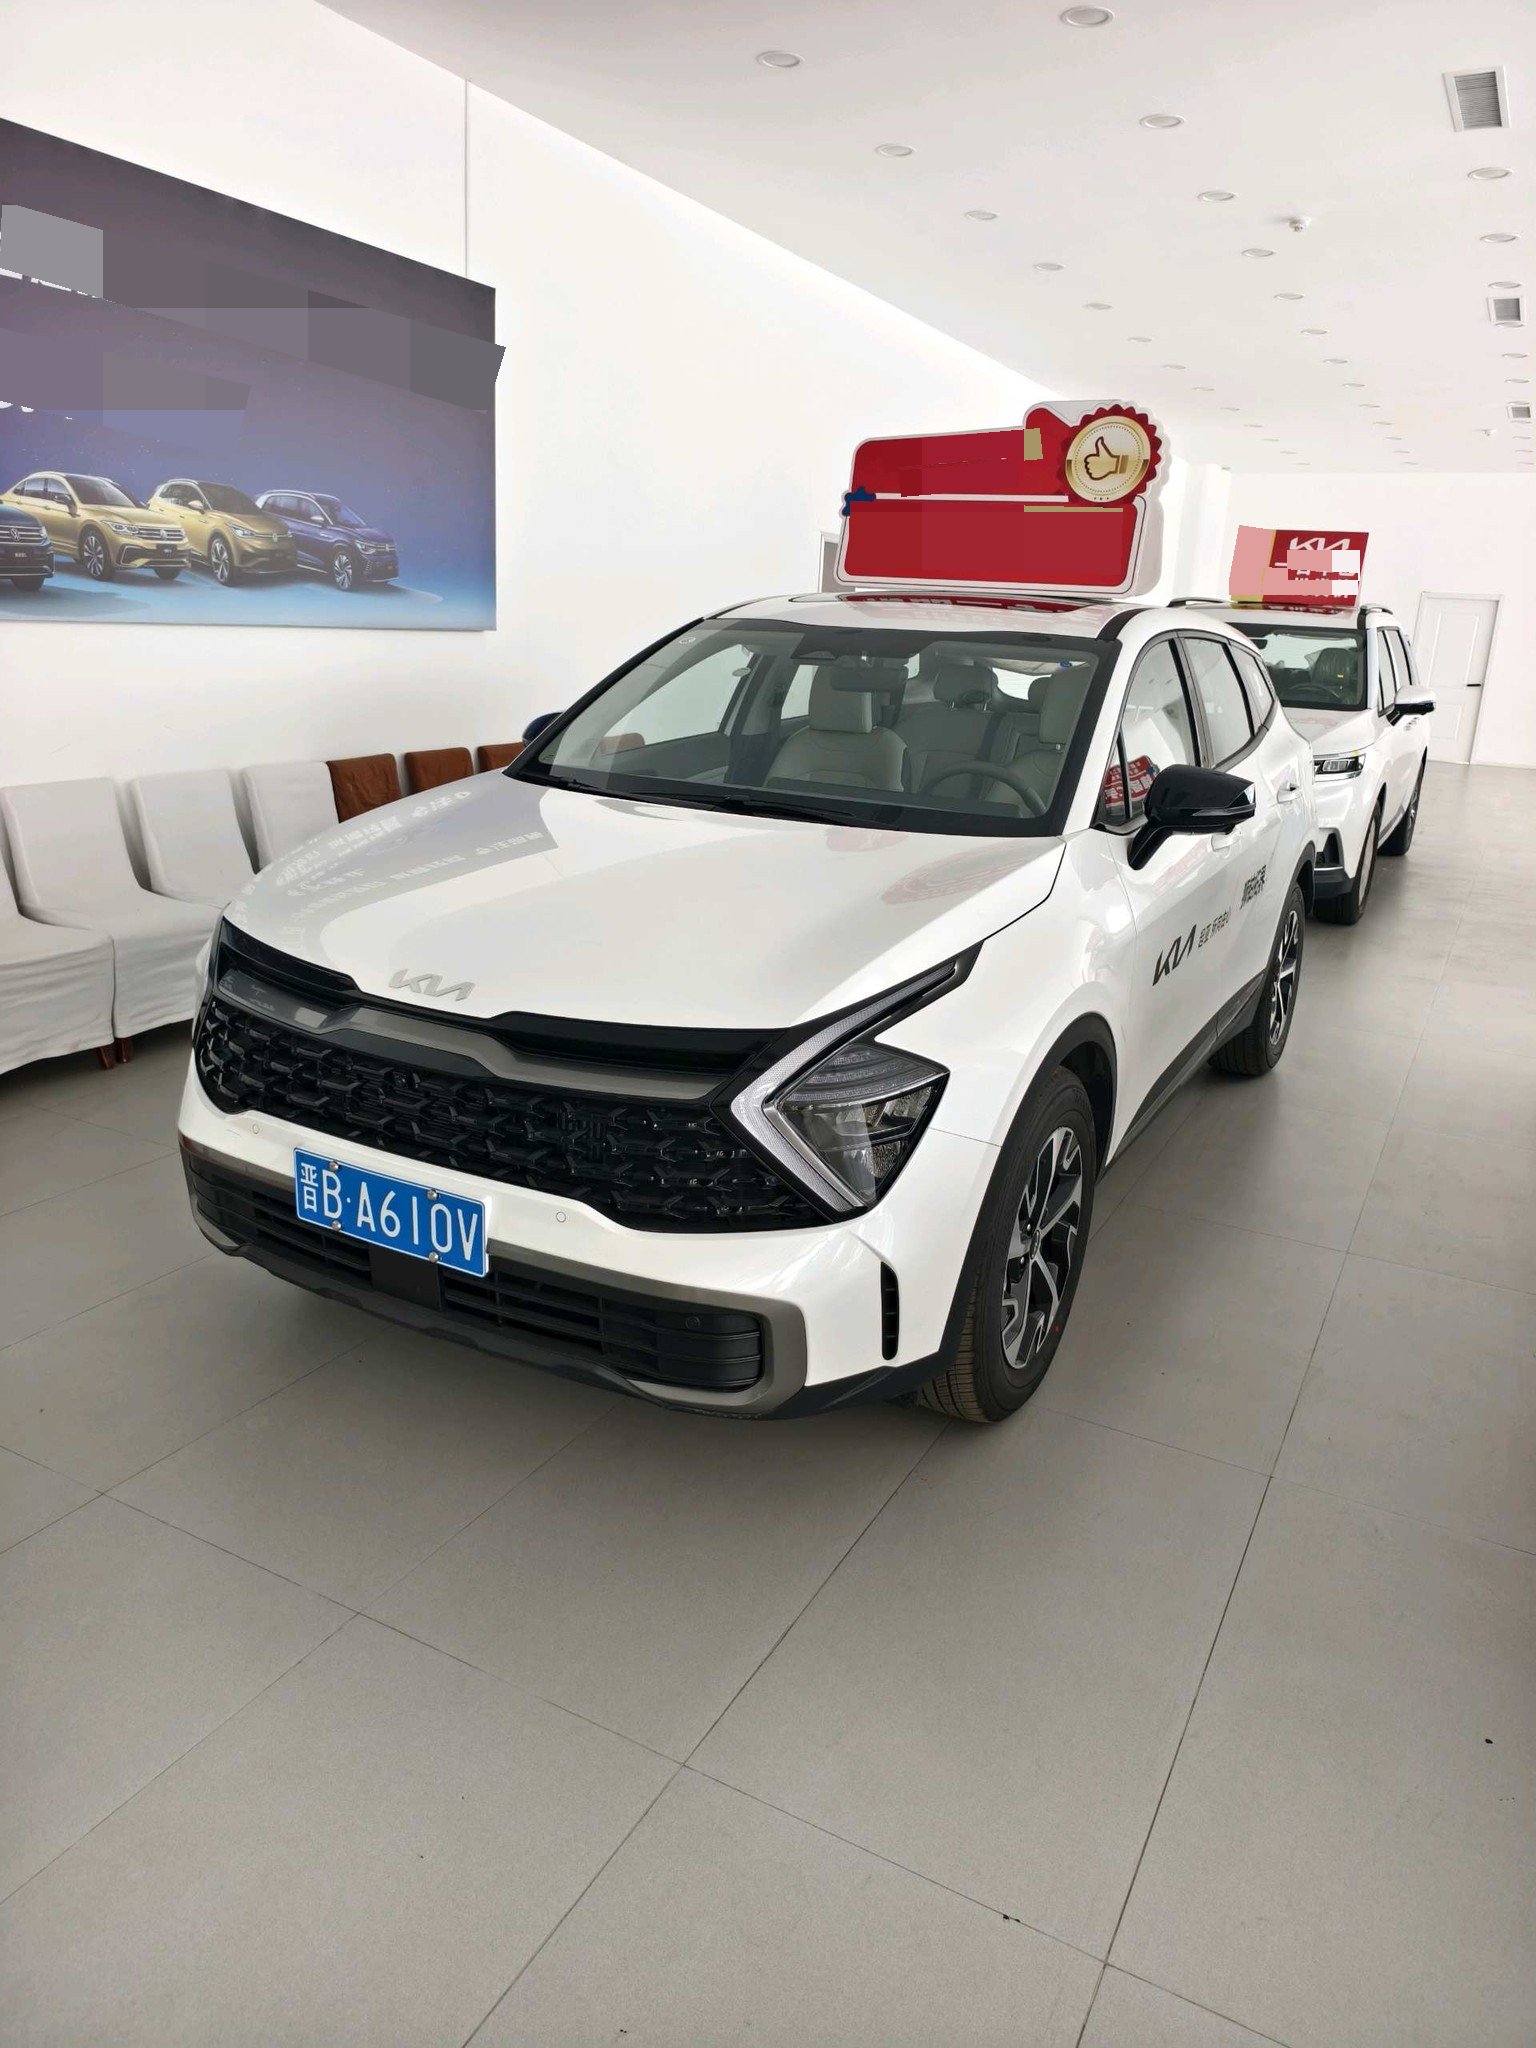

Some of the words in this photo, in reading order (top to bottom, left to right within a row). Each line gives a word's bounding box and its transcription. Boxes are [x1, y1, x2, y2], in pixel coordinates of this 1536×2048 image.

[1289, 536, 1351, 550] KIA
[1152, 923, 1198, 987] KIA
[388, 968, 476, 1002] KIA
